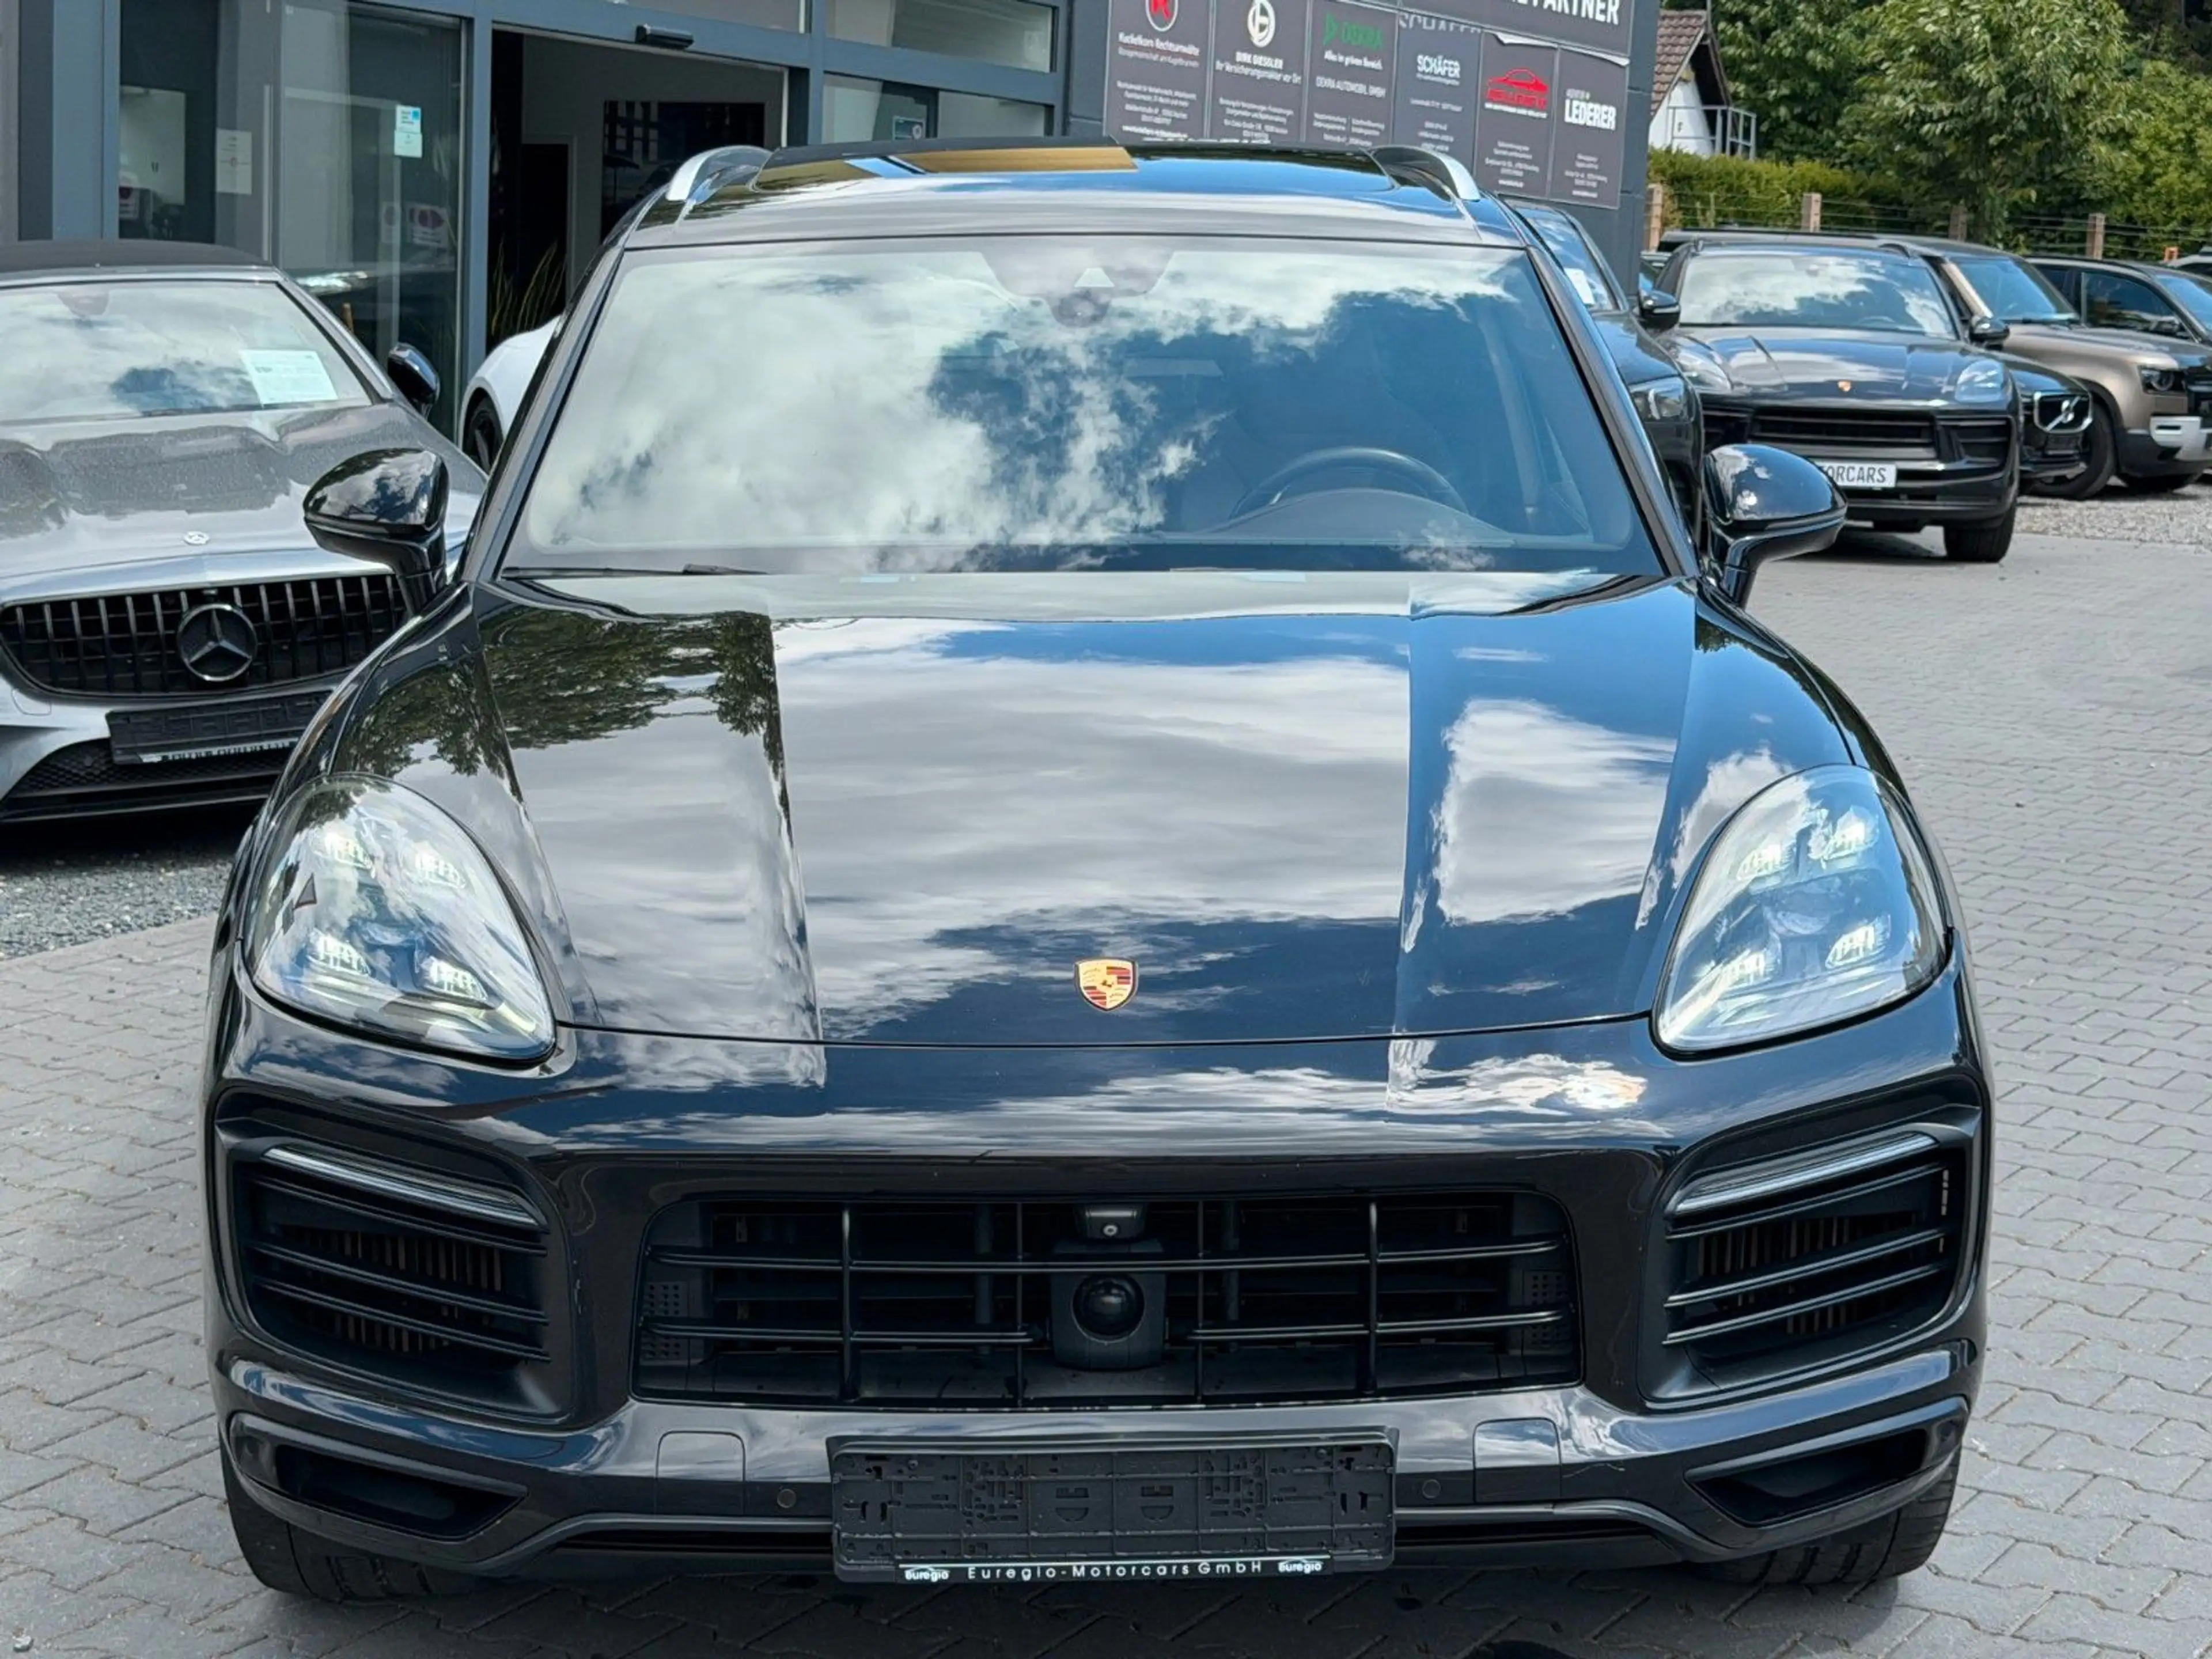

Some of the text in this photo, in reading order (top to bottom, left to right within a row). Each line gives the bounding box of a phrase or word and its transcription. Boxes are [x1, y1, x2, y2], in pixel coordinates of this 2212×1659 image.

[1532, 0, 1619, 25] TNER
[1417, 54, 1461, 78] SCHÄFER
[1564, 99, 1616, 130] LEDERER
[1820, 465, 1887, 483] ORCARS
[968, 1560, 1261, 1581] Euregio-Motorcars GmbH
